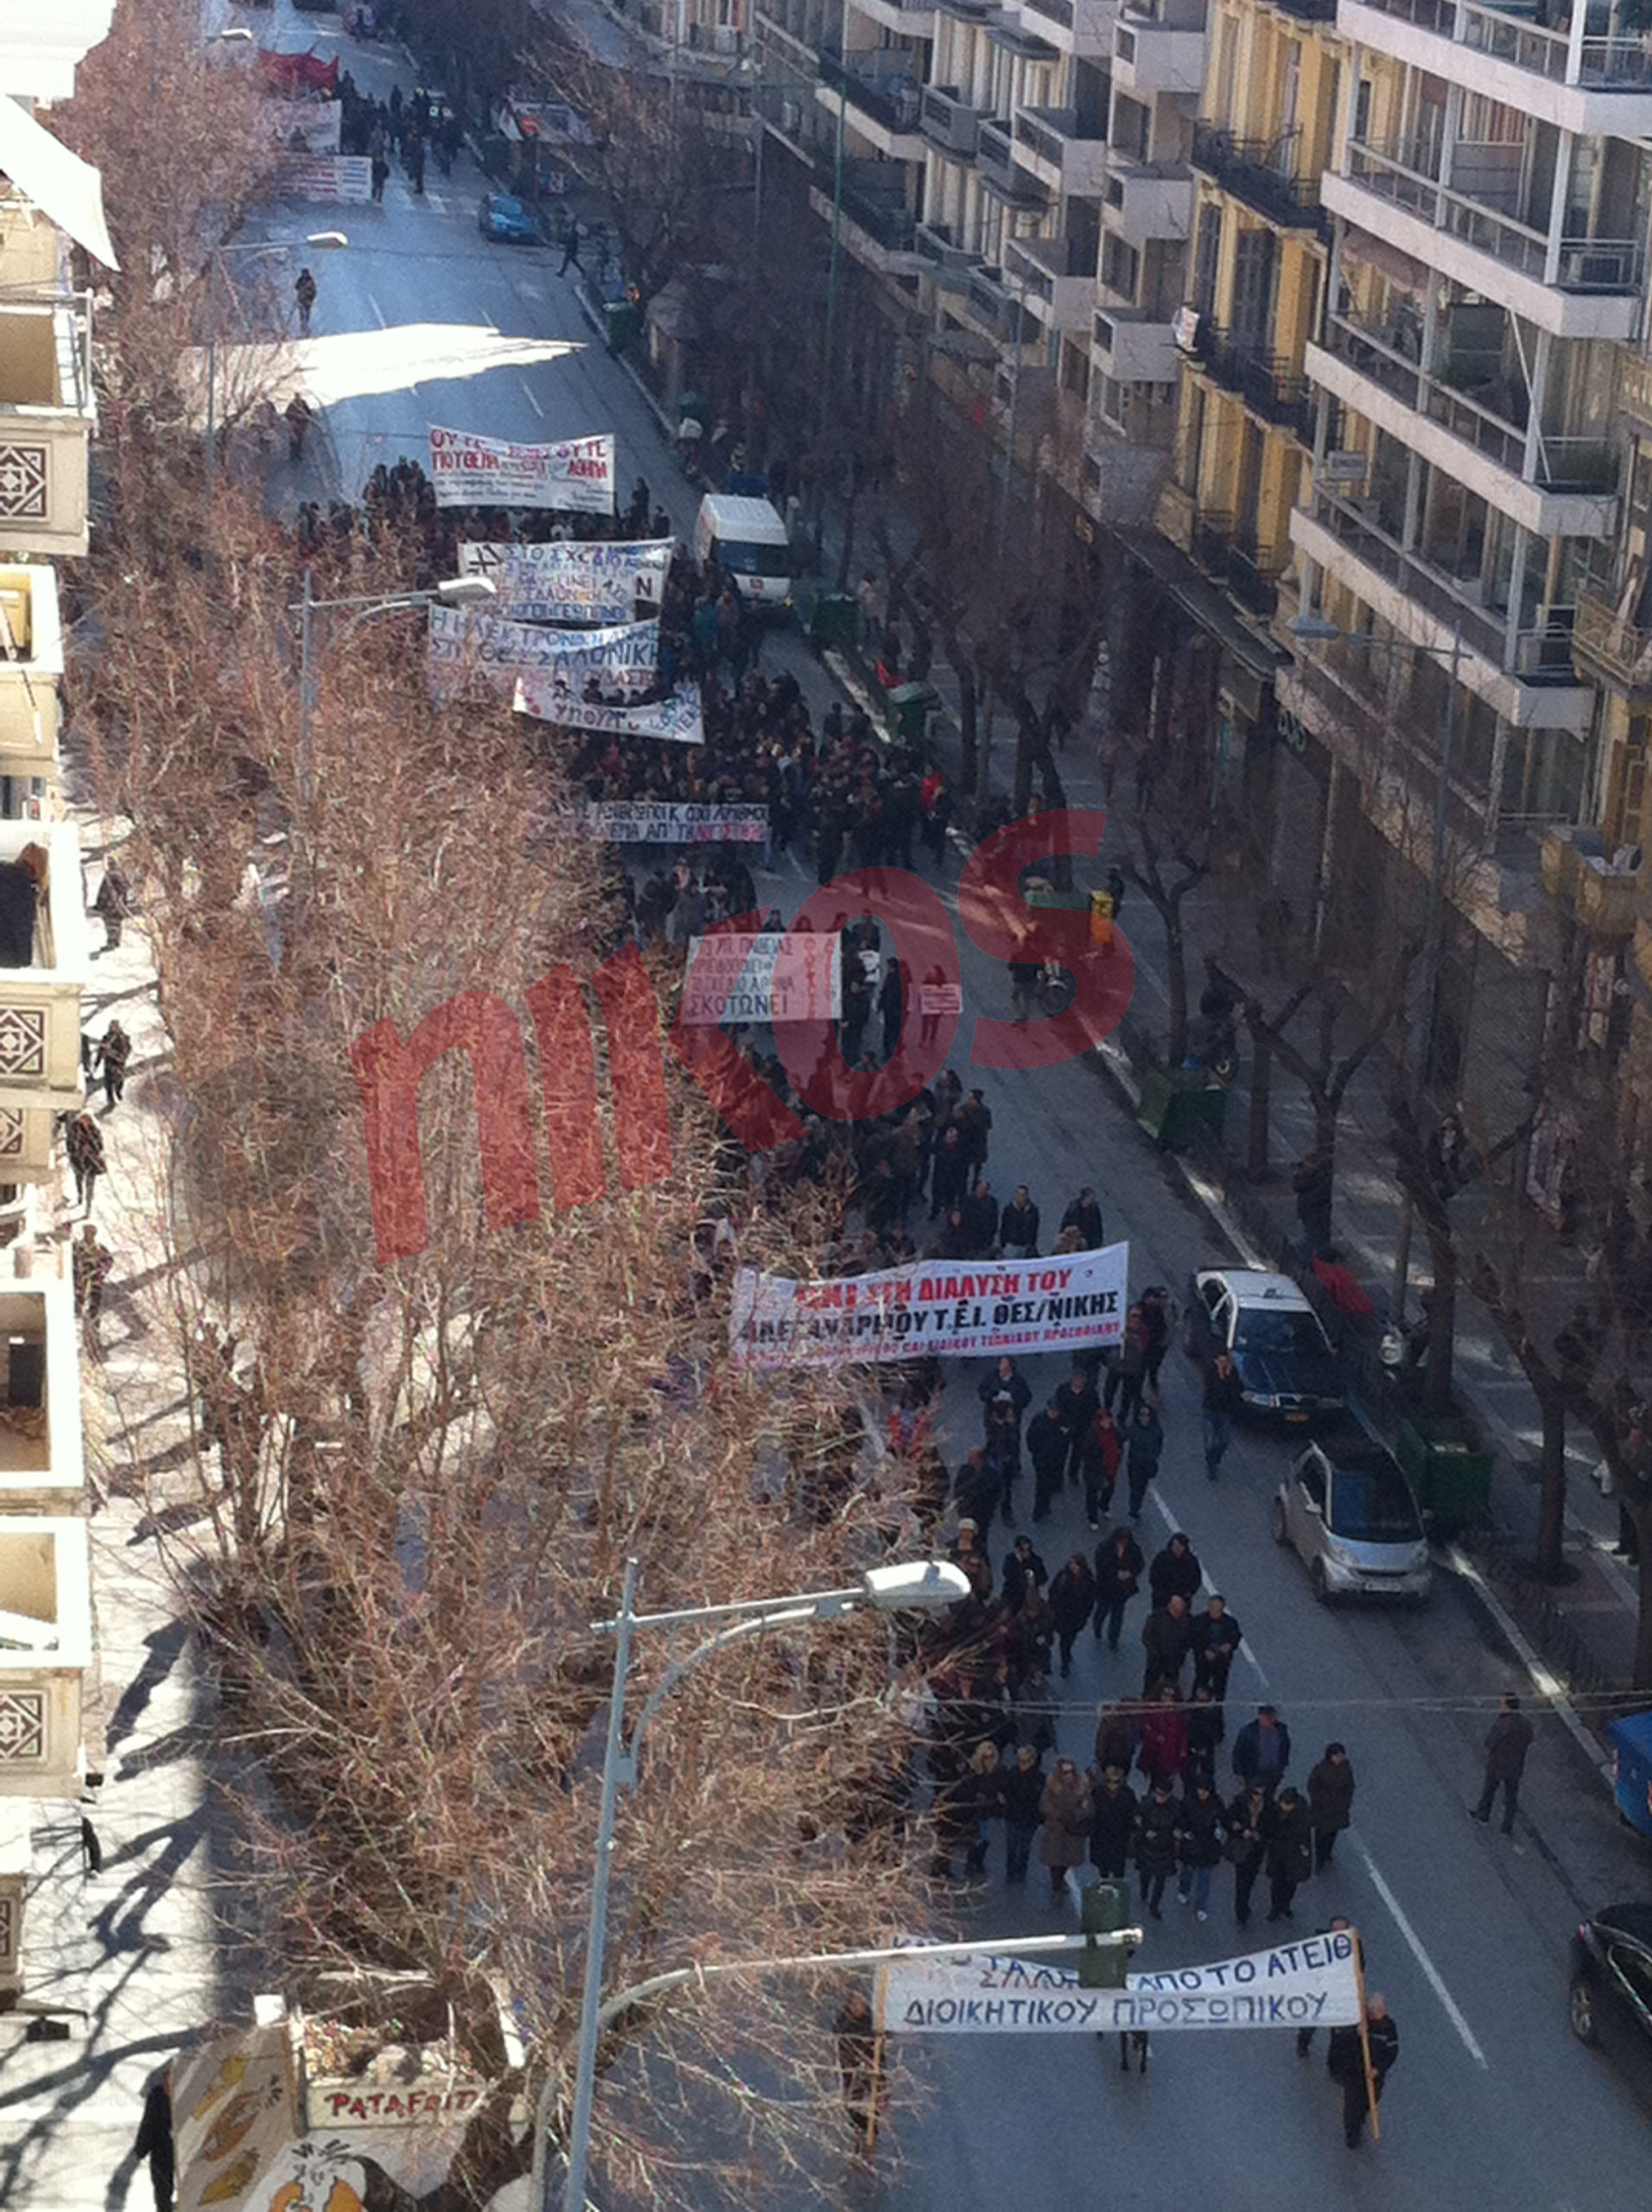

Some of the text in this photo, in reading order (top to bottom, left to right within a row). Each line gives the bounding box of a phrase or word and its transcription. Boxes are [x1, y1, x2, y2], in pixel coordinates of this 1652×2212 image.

[687, 994, 788, 1017] ΣΚΟΤΩΝΕΙ
[918, 1274, 1020, 1302] ΔΙΑΛΥΣΗ
[1027, 1268, 1073, 1293] ΤΟΥ
[994, 1290, 1119, 1326] ΘΕΣ/ΝΙΚΗΣ
[1206, 1960, 1256, 1986] ΤΟ
[1268, 1933, 1353, 1979] ΑΤΕΙΘ
[904, 1990, 1329, 2025] ΔΙΟΙΚΗΤΙΚΟΥ ΠΡΟΣΩΠΙΚΟΥ
